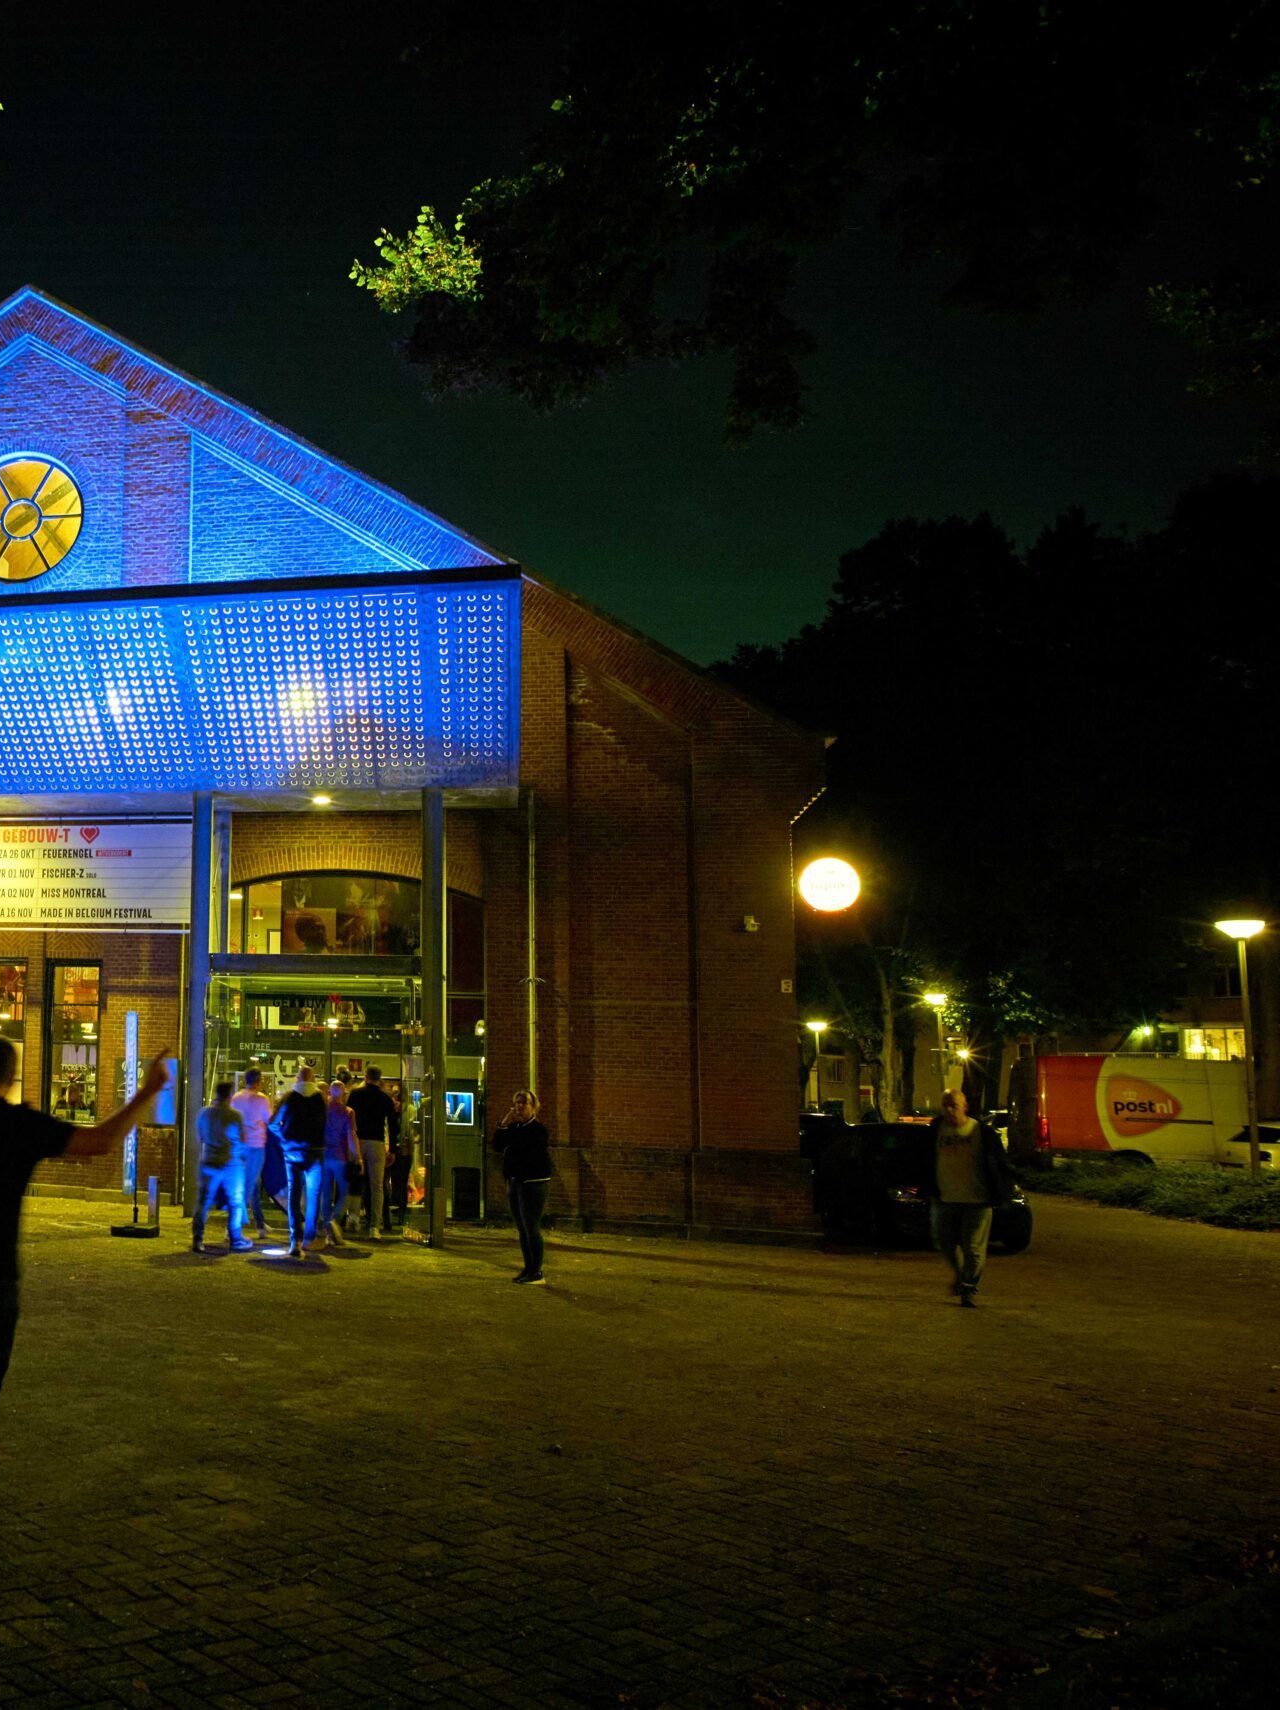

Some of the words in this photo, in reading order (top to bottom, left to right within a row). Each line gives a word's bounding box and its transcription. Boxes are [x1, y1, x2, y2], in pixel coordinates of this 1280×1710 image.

[3, 828, 71, 844] GEBOUW-T
[9, 849, 19, 858] 26
[20, 849, 35, 858] OKT
[42, 849, 94, 858] FEUERENGEL
[8, 869, 17, 878] 01
[19, 869, 35, 878] NOV
[42, 869, 85, 878] FISCHER-Z
[7, 888, 17, 898] 02
[19, 888, 35, 898] NOV
[41, 888, 61, 898] MISS
[62, 888, 107, 898] MONTREAL
[6, 908, 16, 918] 16
[17, 908, 33, 918] NOV
[40, 908, 62, 918] MADE
[65, 908, 73, 918] IN
[75, 908, 112, 918] BELGIUM
[113, 908, 153, 918] FESTIVAL
